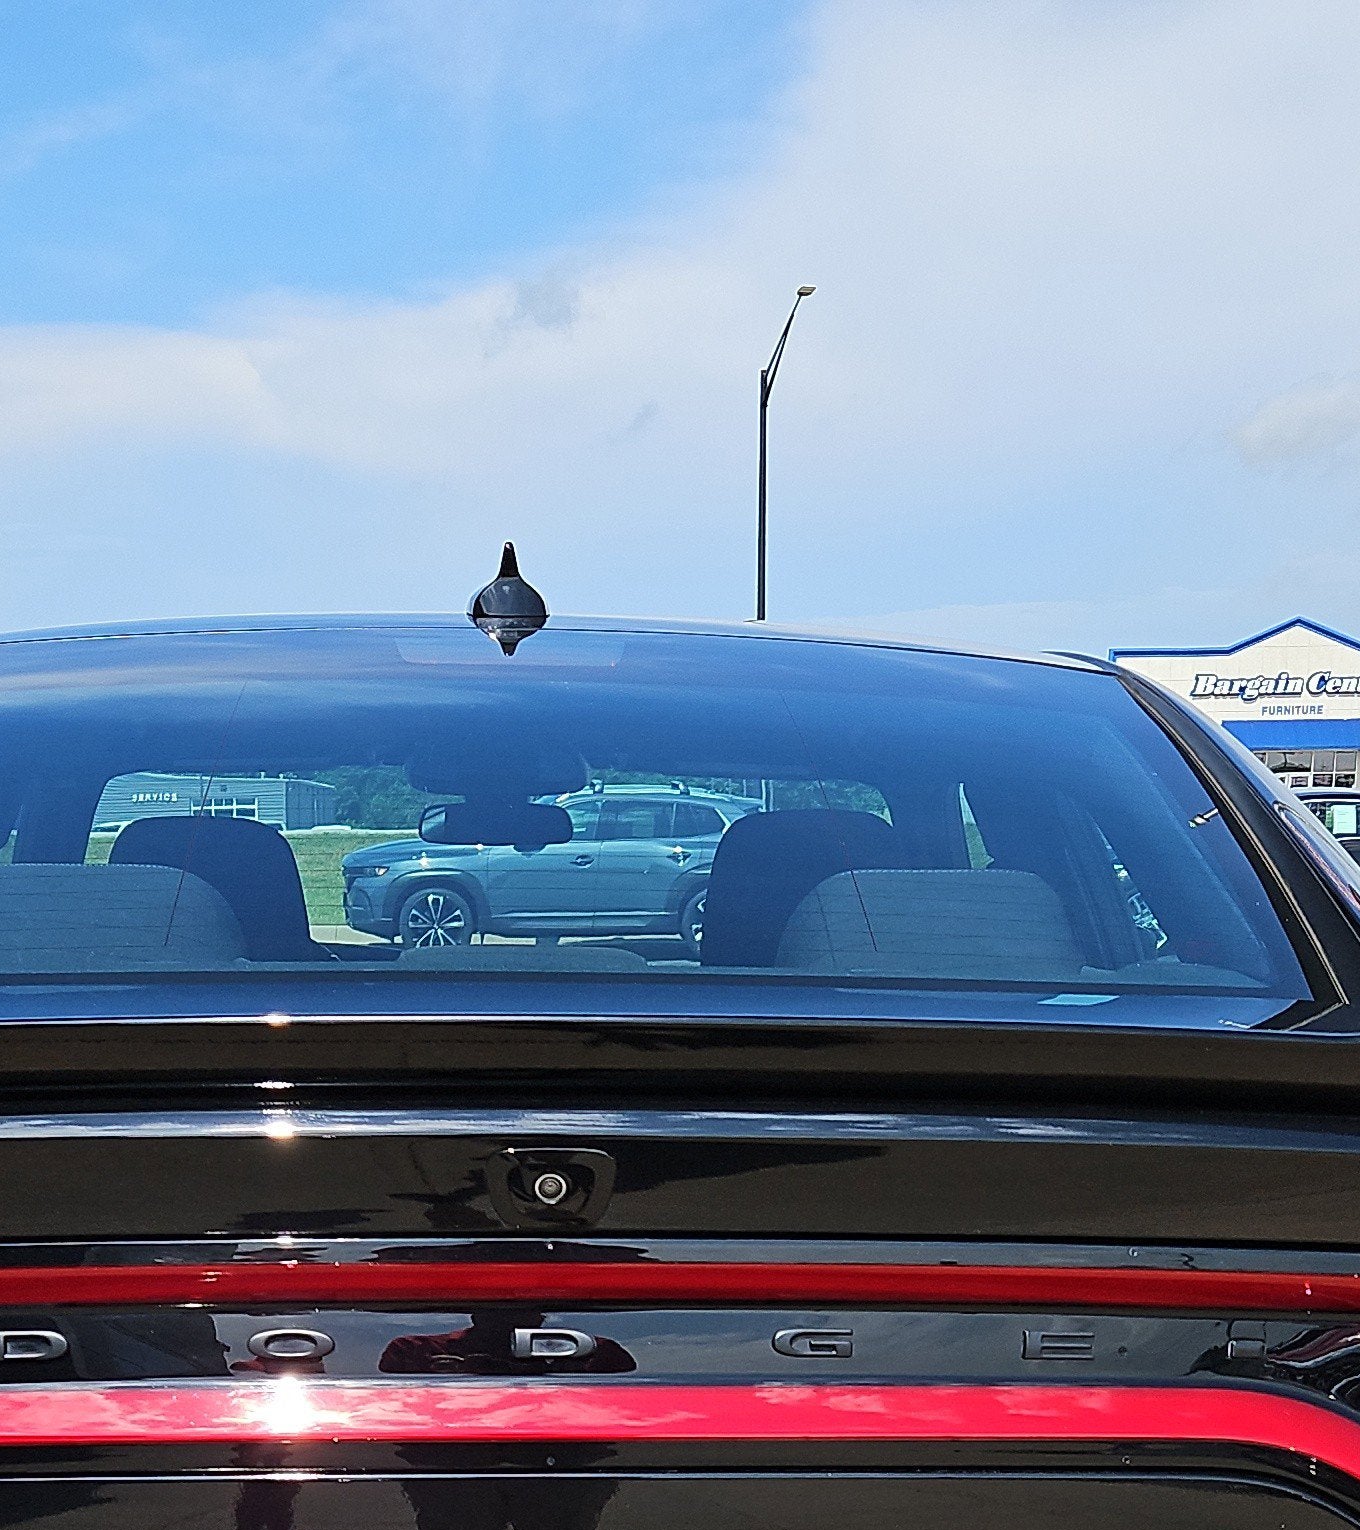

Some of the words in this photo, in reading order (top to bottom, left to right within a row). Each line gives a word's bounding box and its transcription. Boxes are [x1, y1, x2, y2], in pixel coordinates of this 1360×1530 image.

[1190, 672, 1304, 702] Bargain
[1261, 704, 1324, 716] FURNITURE
[131, 793, 178, 803] SERVICE
